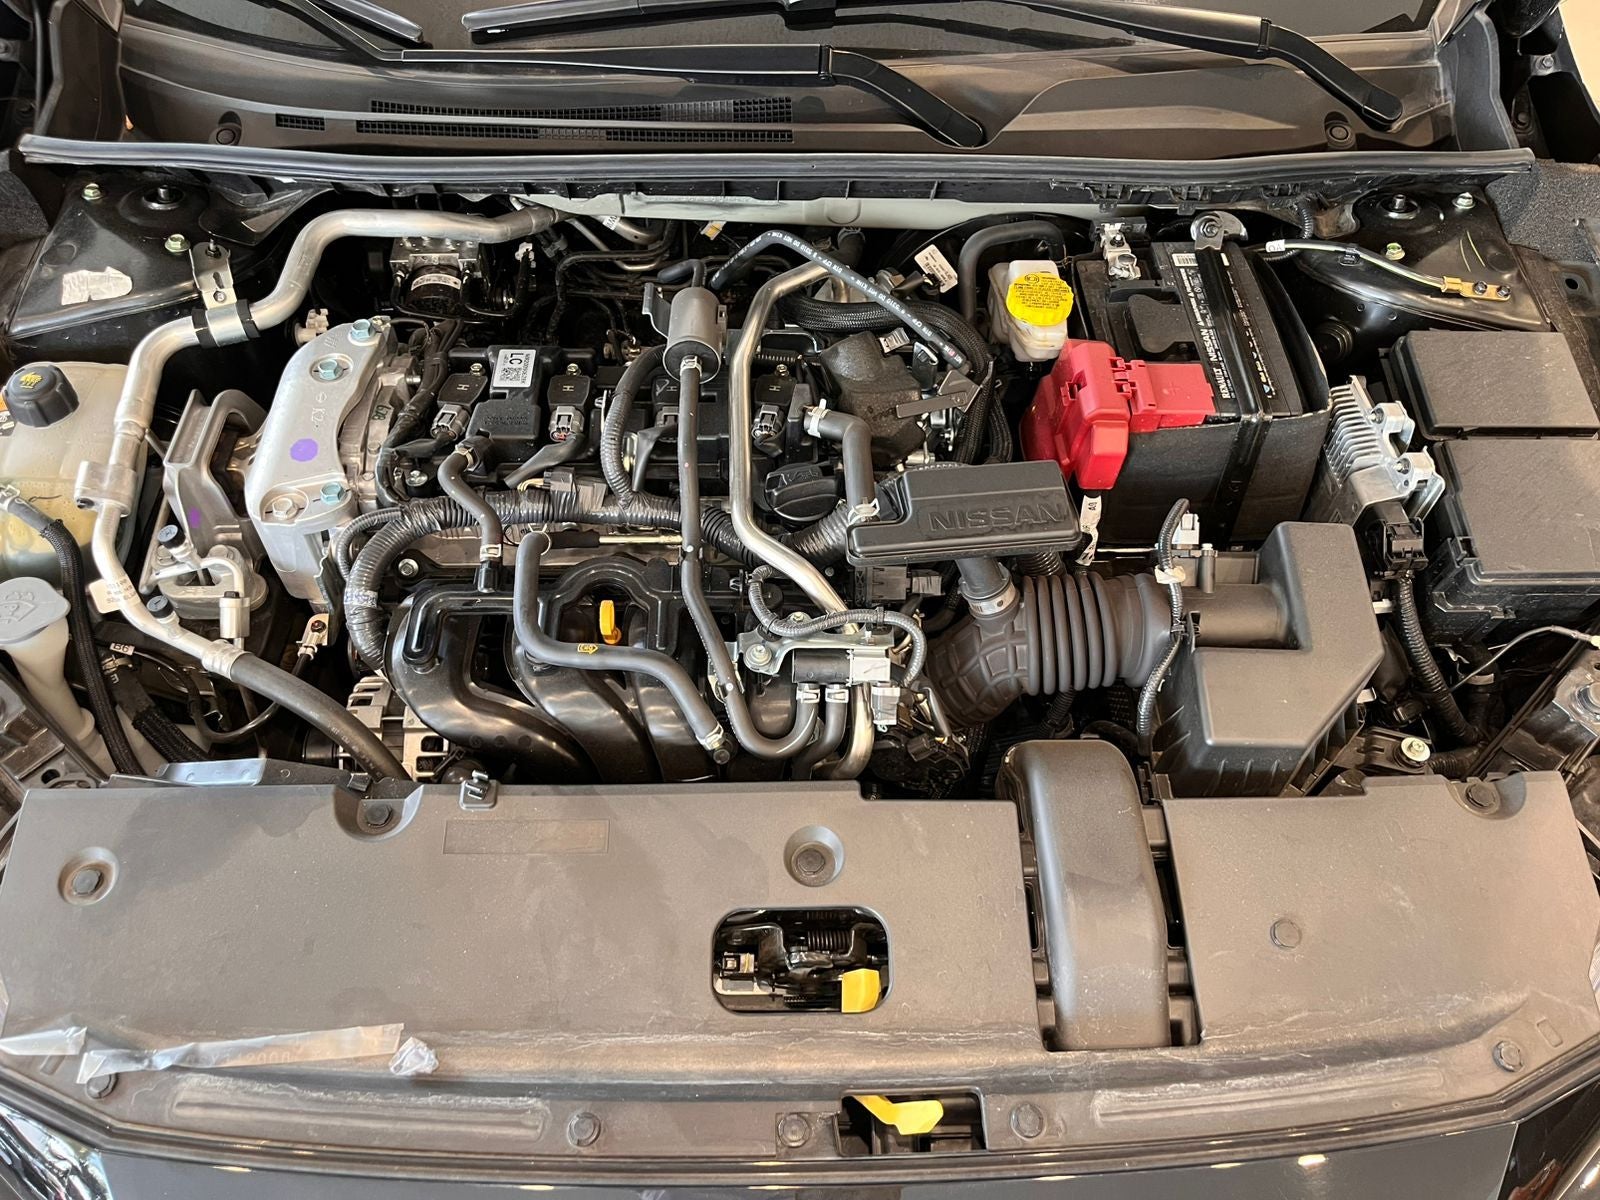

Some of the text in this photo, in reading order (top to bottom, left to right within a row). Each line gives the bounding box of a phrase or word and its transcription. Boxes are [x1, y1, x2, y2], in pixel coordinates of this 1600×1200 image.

[509, 352, 524, 365] LC
[1200, 328, 1218, 362] NISSAN
[1212, 367, 1231, 399] RENAULT
[929, 503, 1068, 531] NISSAN
